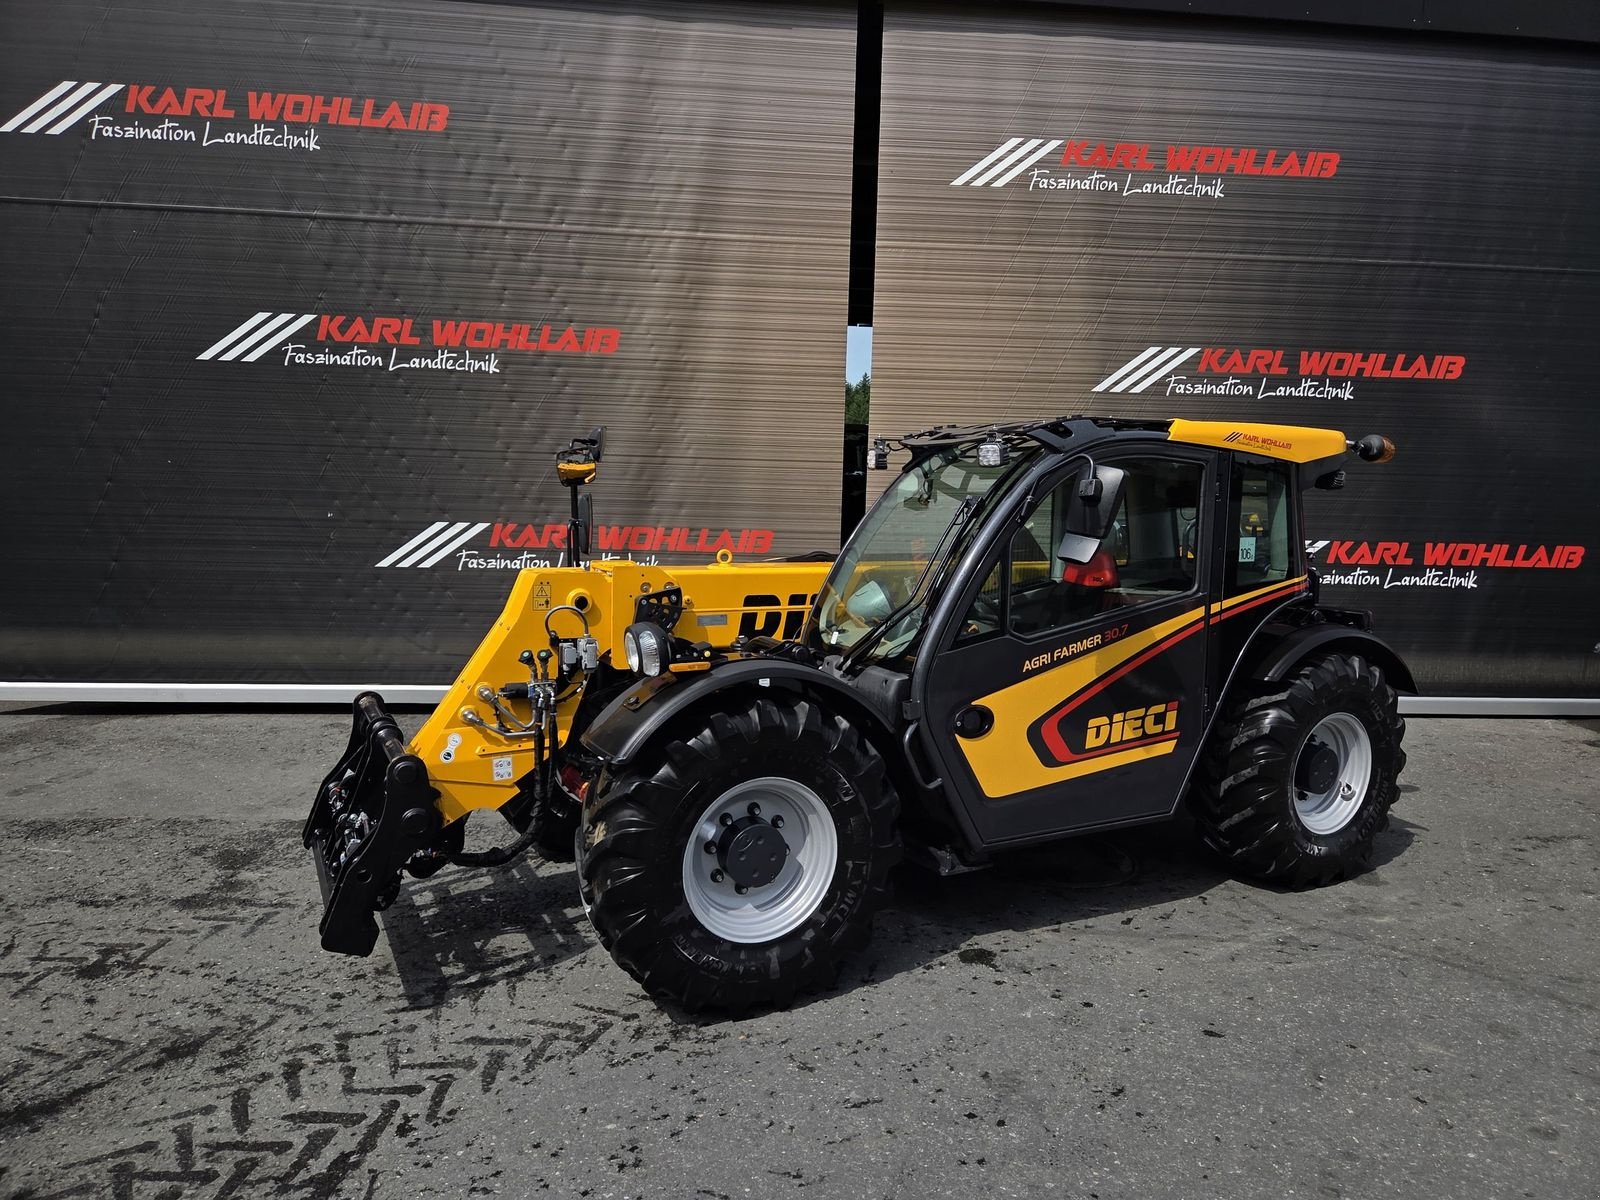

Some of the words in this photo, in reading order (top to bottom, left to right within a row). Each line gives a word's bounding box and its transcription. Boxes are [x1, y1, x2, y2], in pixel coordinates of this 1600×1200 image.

[127, 85, 236, 117] KARL
[89, 115, 196, 141] Faszination
[203, 121, 320, 151] Landtechnik
[1061, 140, 1155, 170] KARL
[1029, 168, 1119, 191] Faszination
[1122, 173, 1224, 198] Landtechnik
[317, 315, 420, 346] KARL
[282, 343, 383, 366] Faszination
[389, 348, 500, 373] Landtechnik
[1198, 348, 1289, 375] KARL
[1166, 375, 1253, 396] Faszination
[1258, 378, 1354, 400] Landtechnik
[489, 523, 573, 548] KAR
[456, 550, 551, 571] Faszination
[1327, 540, 1413, 566] KARL
[1384, 568, 1478, 590] Landtechnik
[1022, 651, 1051, 673] AGRI
[1053, 634, 1102, 661] FARMER
[1103, 623, 1129, 643] 30.7
